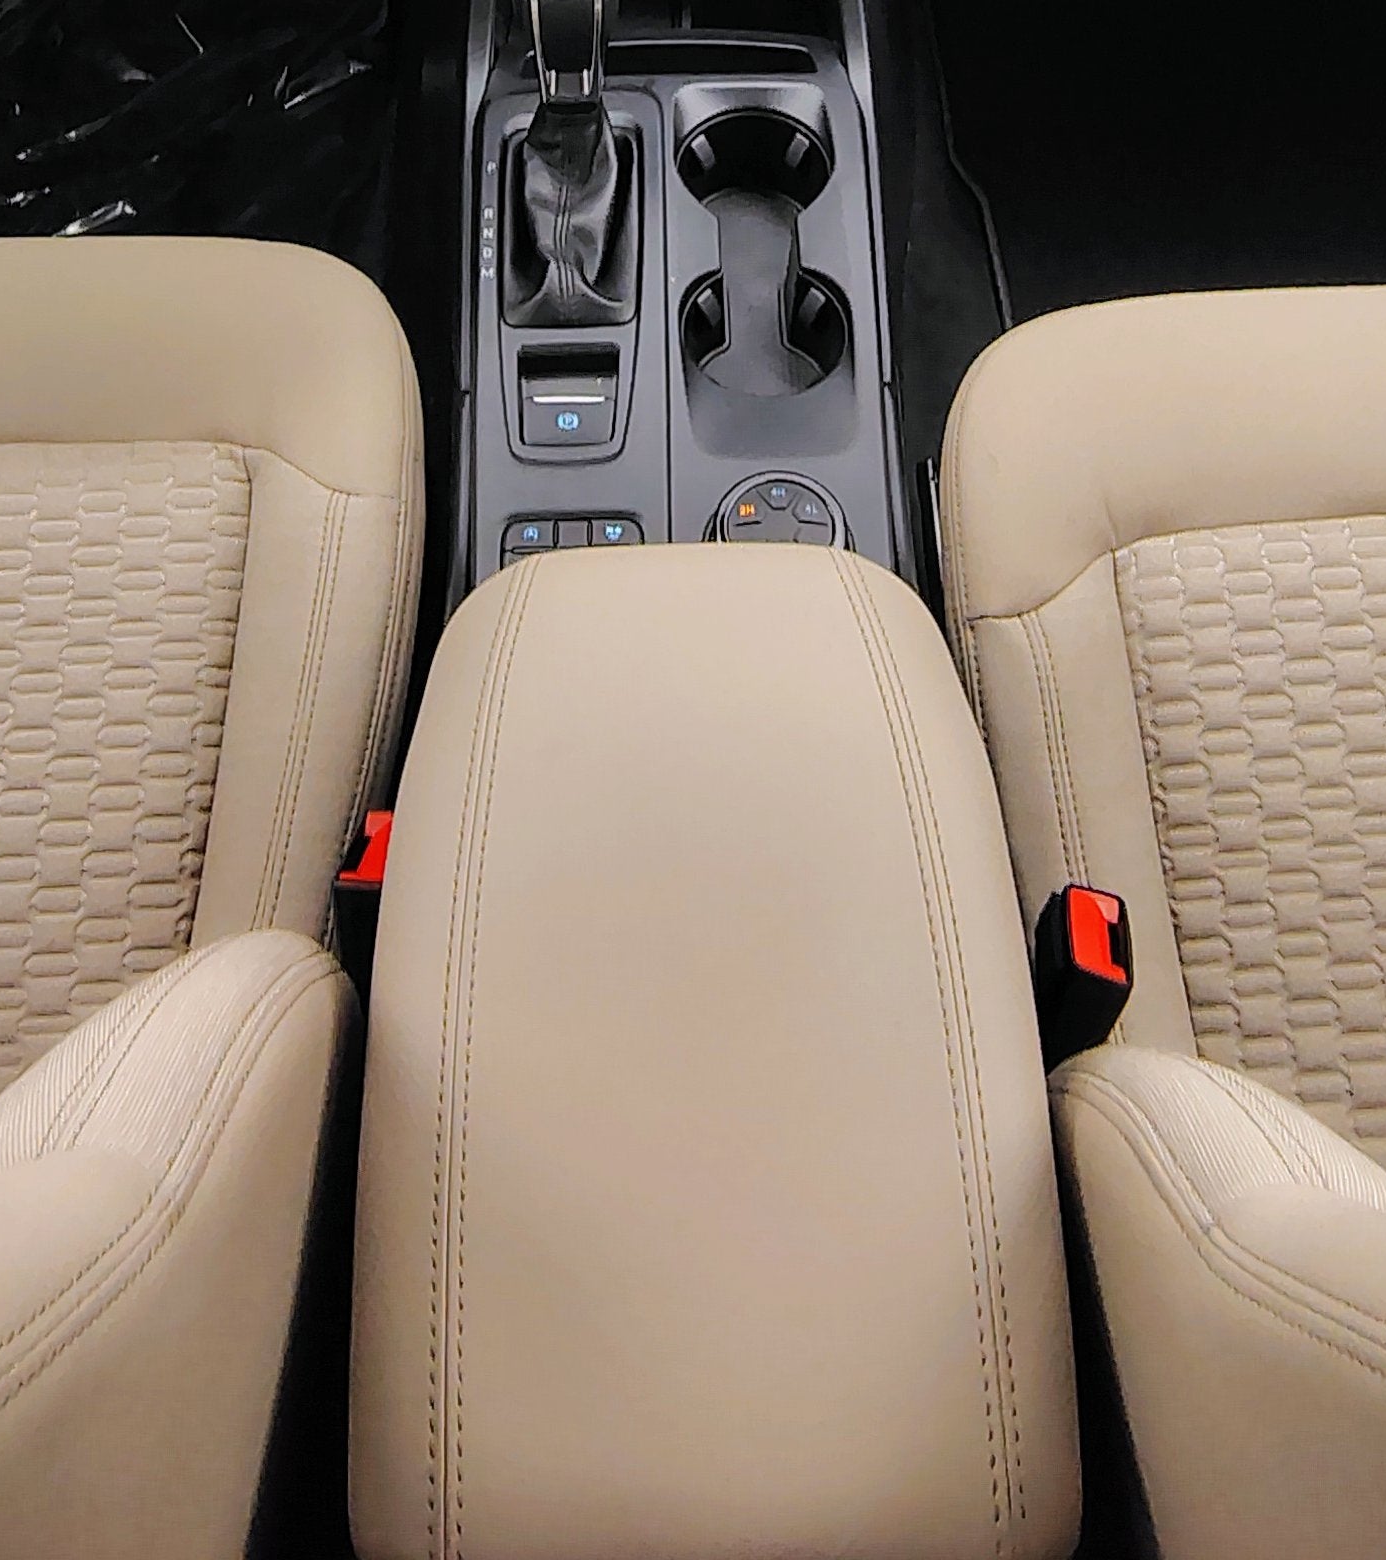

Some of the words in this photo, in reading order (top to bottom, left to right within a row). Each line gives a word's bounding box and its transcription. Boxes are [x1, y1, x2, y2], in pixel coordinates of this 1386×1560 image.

[482, 227, 494, 239] N
[482, 246, 494, 259] D
[480, 266, 494, 280] M
